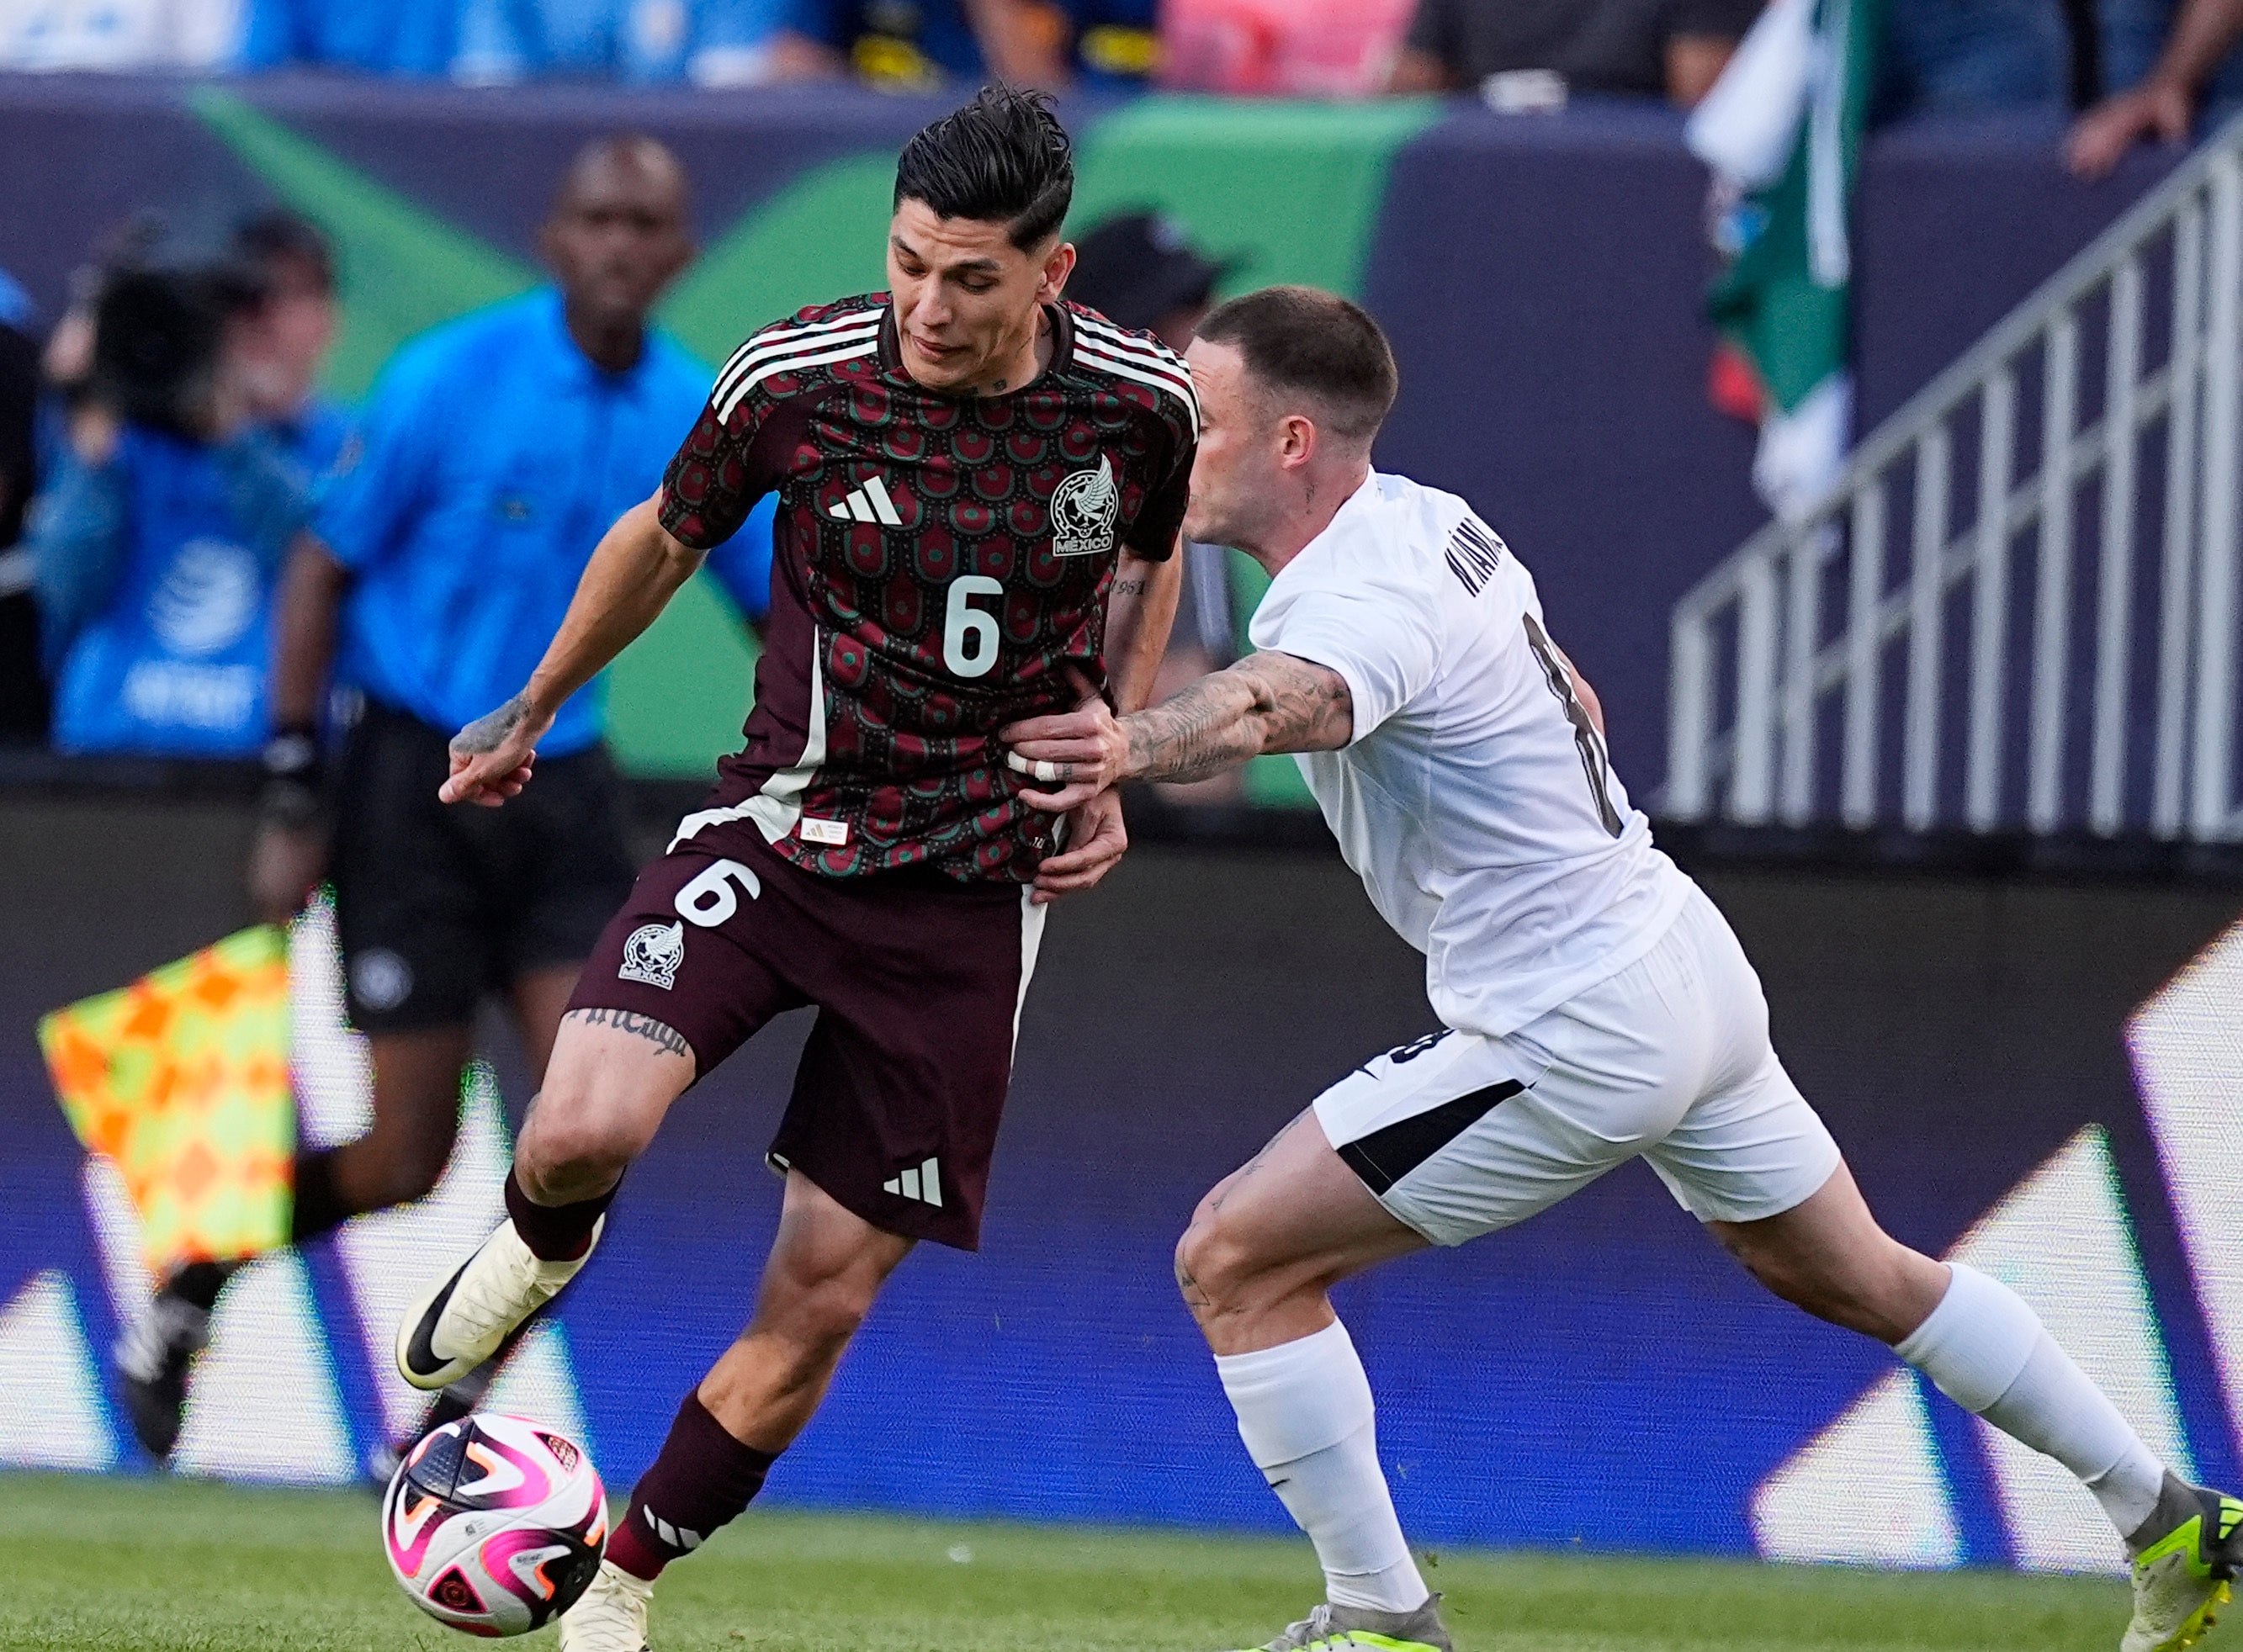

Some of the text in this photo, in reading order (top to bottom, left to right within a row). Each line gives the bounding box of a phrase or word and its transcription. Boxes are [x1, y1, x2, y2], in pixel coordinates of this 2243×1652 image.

[1056, 536, 1111, 553] MÉXICO
[943, 574, 1004, 678] 6
[674, 859, 761, 927] 6
